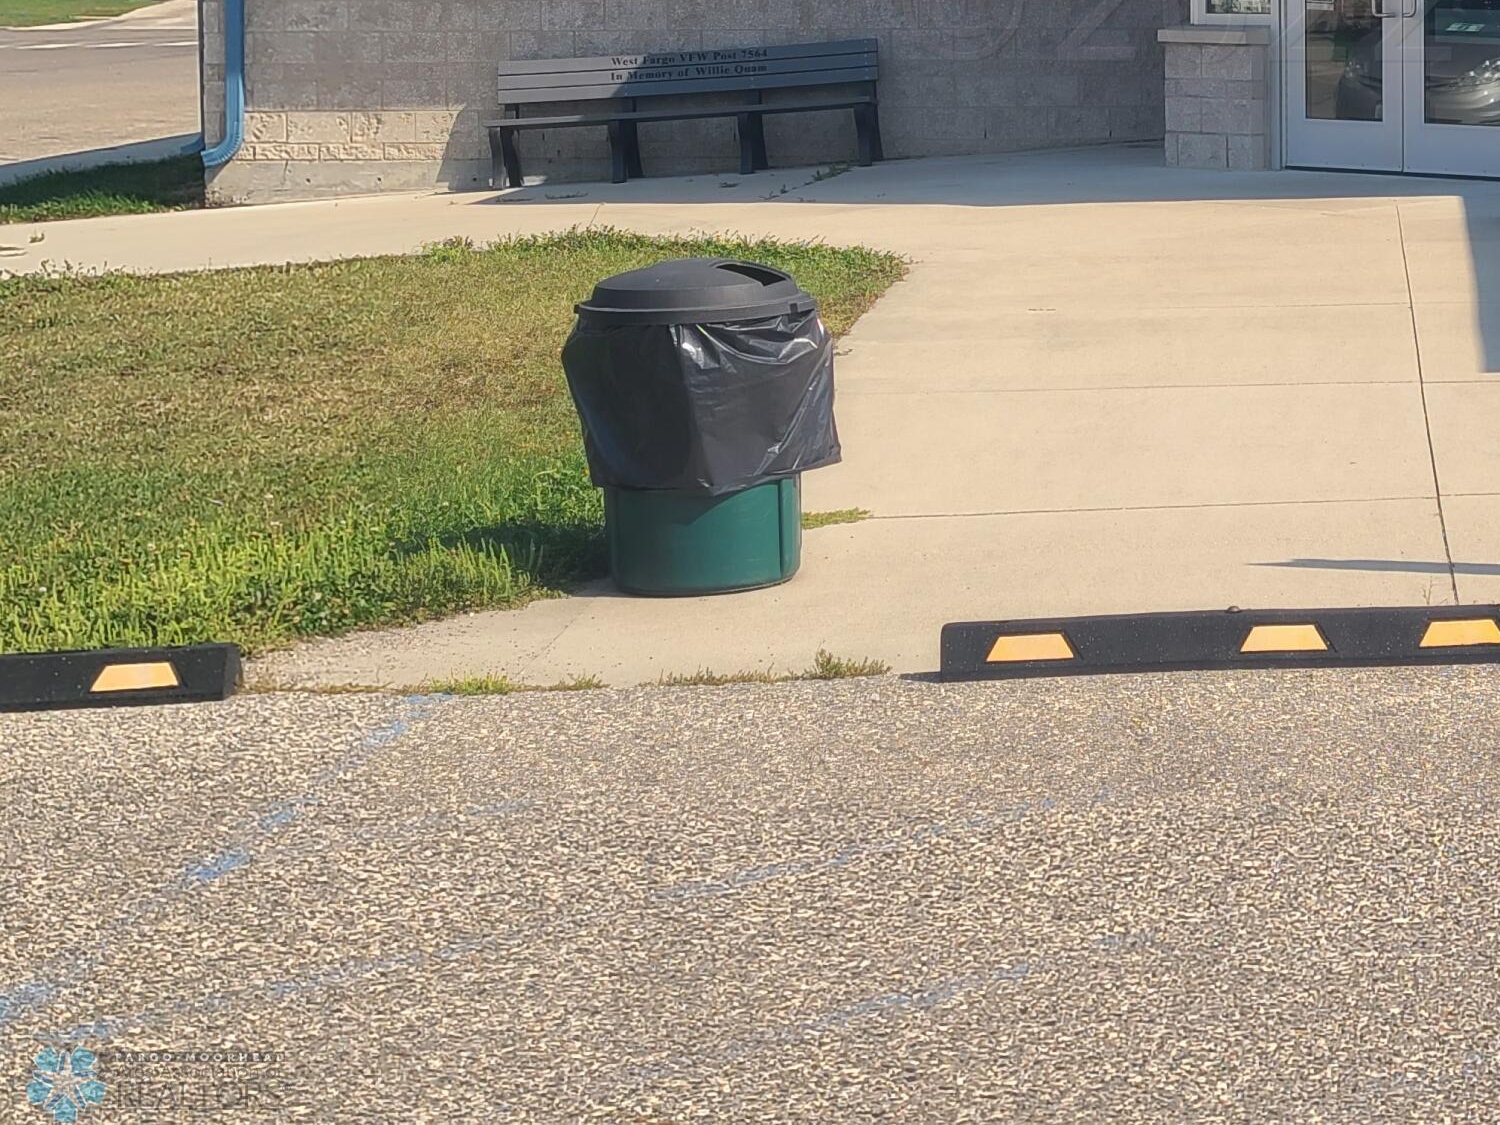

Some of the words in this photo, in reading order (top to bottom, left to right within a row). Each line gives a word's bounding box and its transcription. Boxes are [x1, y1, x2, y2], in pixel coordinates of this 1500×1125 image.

[611, 57, 638, 66] West
[643, 55, 675, 66] Fargo
[680, 52, 710, 62] VFW
[713, 50, 737, 61] Post
[741, 49, 768, 59] 7564
[611, 72, 623, 81] In
[628, 70, 673, 81] Memory
[678, 68, 690, 77] of
